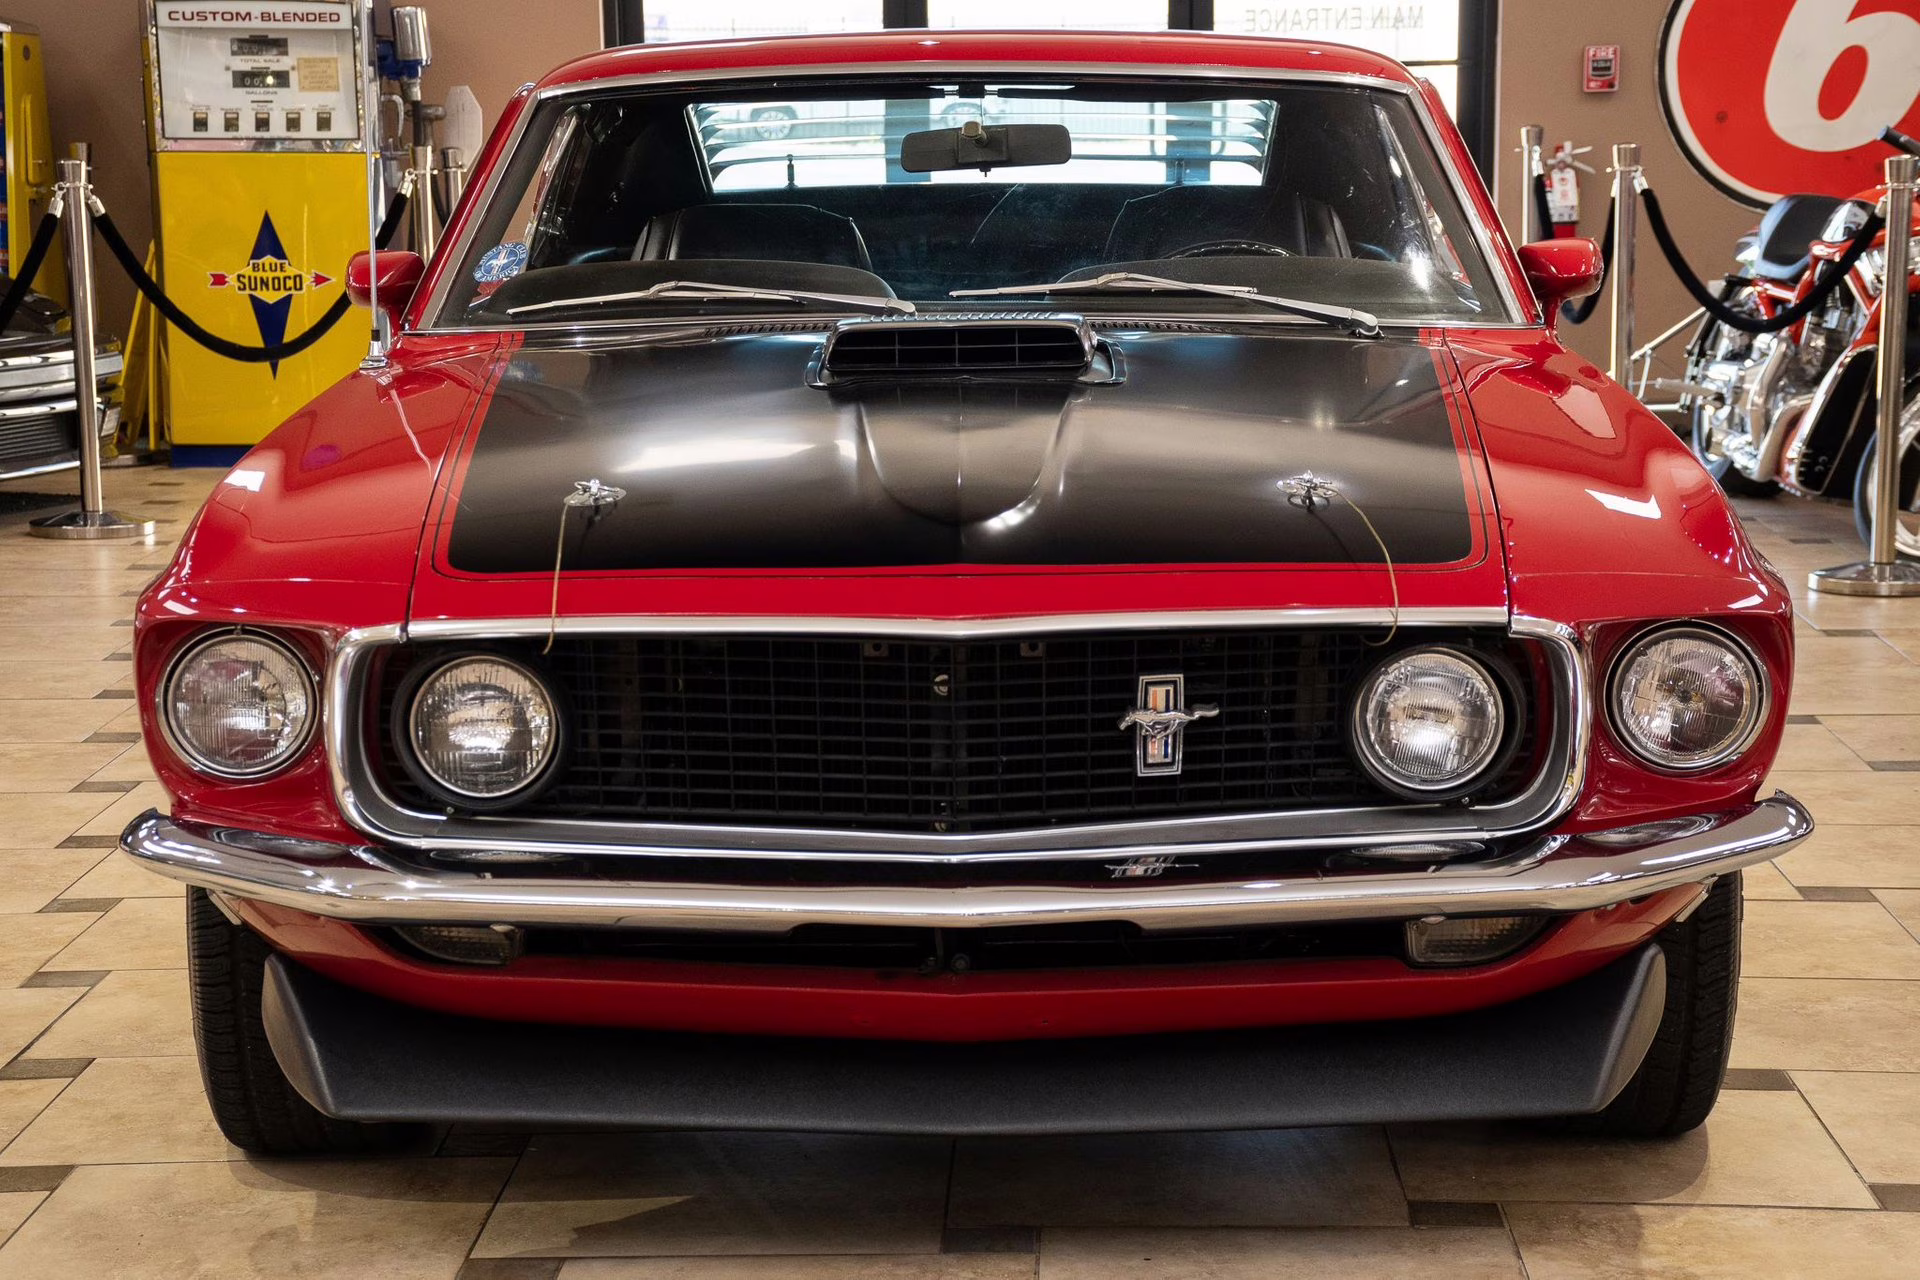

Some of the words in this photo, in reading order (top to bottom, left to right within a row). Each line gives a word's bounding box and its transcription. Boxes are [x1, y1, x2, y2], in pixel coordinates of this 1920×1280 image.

[1589, 47, 1615, 58] FIRE
[1764, 0, 1920, 153] 6
[252, 263, 286, 272] BLUE
[237, 274, 303, 291] SUNOCO
